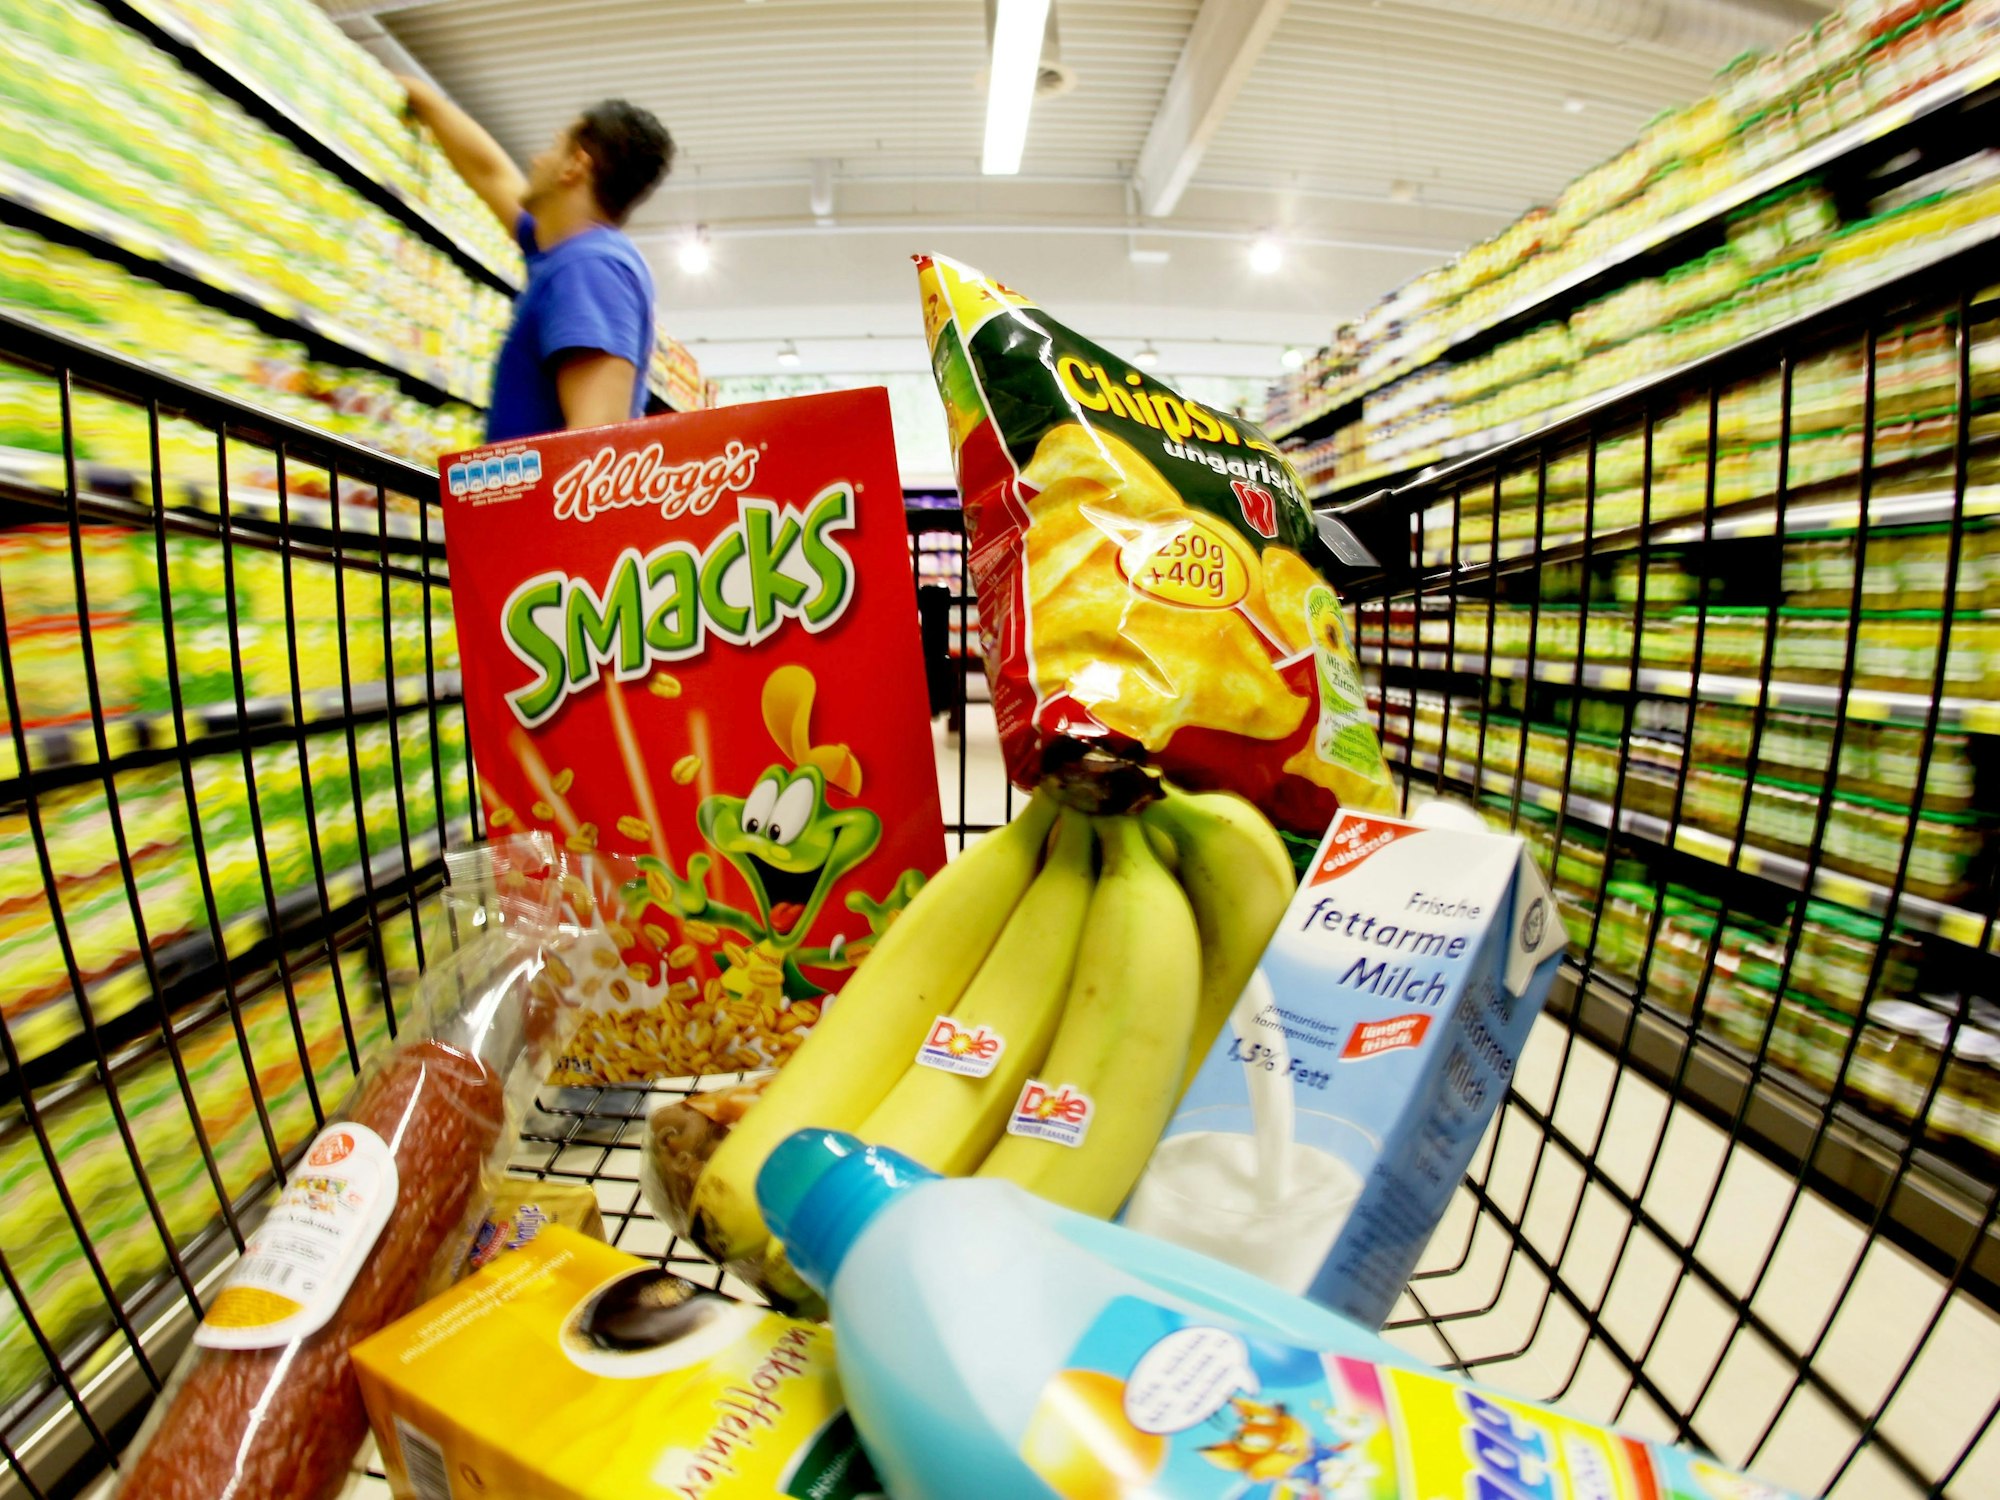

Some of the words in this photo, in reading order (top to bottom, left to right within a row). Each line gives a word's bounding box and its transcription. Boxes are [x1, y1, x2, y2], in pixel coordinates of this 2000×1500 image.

[552, 440, 759, 522] Kellogg's
[1146, 564, 1225, 599] +40g
[1404, 891, 1481, 920] Frische
[1300, 896, 1470, 960] fettarme
[1337, 956, 1448, 1007] Milch
[926, 1020, 999, 1059] Dole
[1287, 1057, 1332, 1091] Fett
[1020, 1085, 1087, 1123] Dole
